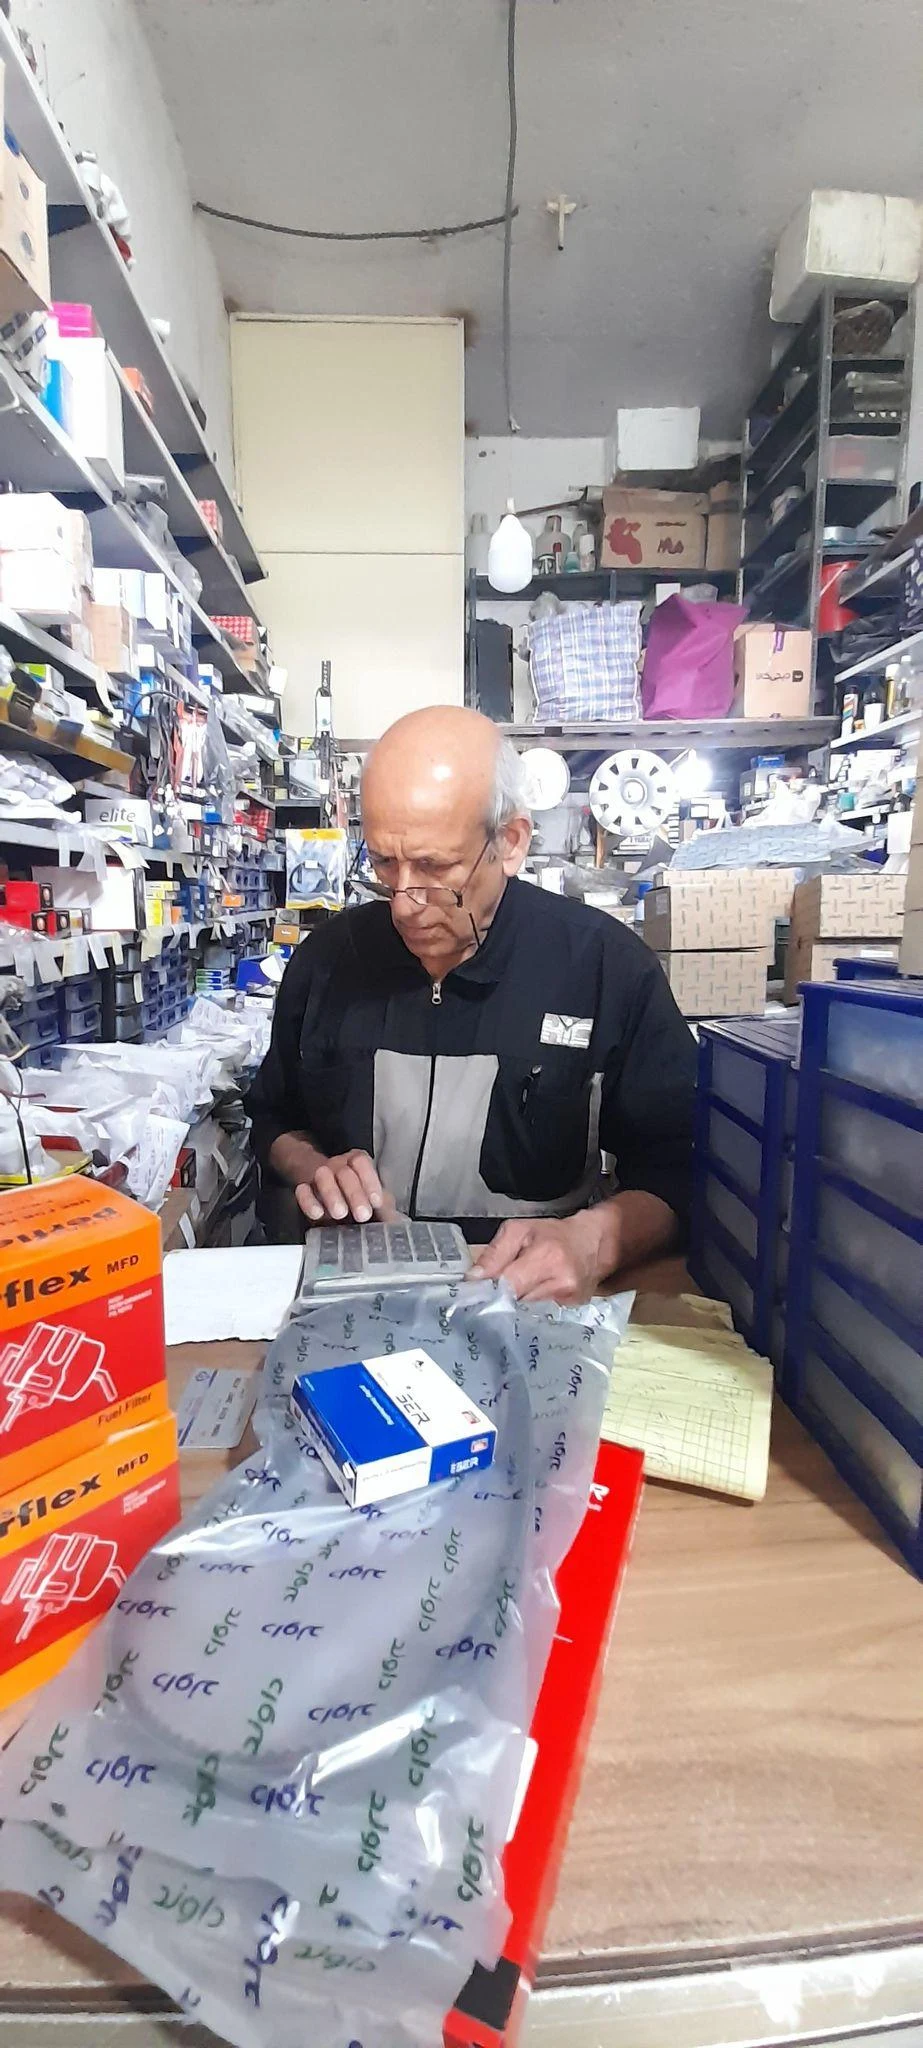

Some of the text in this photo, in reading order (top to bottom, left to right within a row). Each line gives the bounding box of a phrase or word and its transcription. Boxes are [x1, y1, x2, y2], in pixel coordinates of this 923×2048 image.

[99, 807, 136, 823] elite
[0, 1264, 92, 1309] flex
[106, 1254, 139, 1275] MFD
[98, 1391, 152, 1426] Fuel Filter
[117, 1452, 149, 1478] MFD
